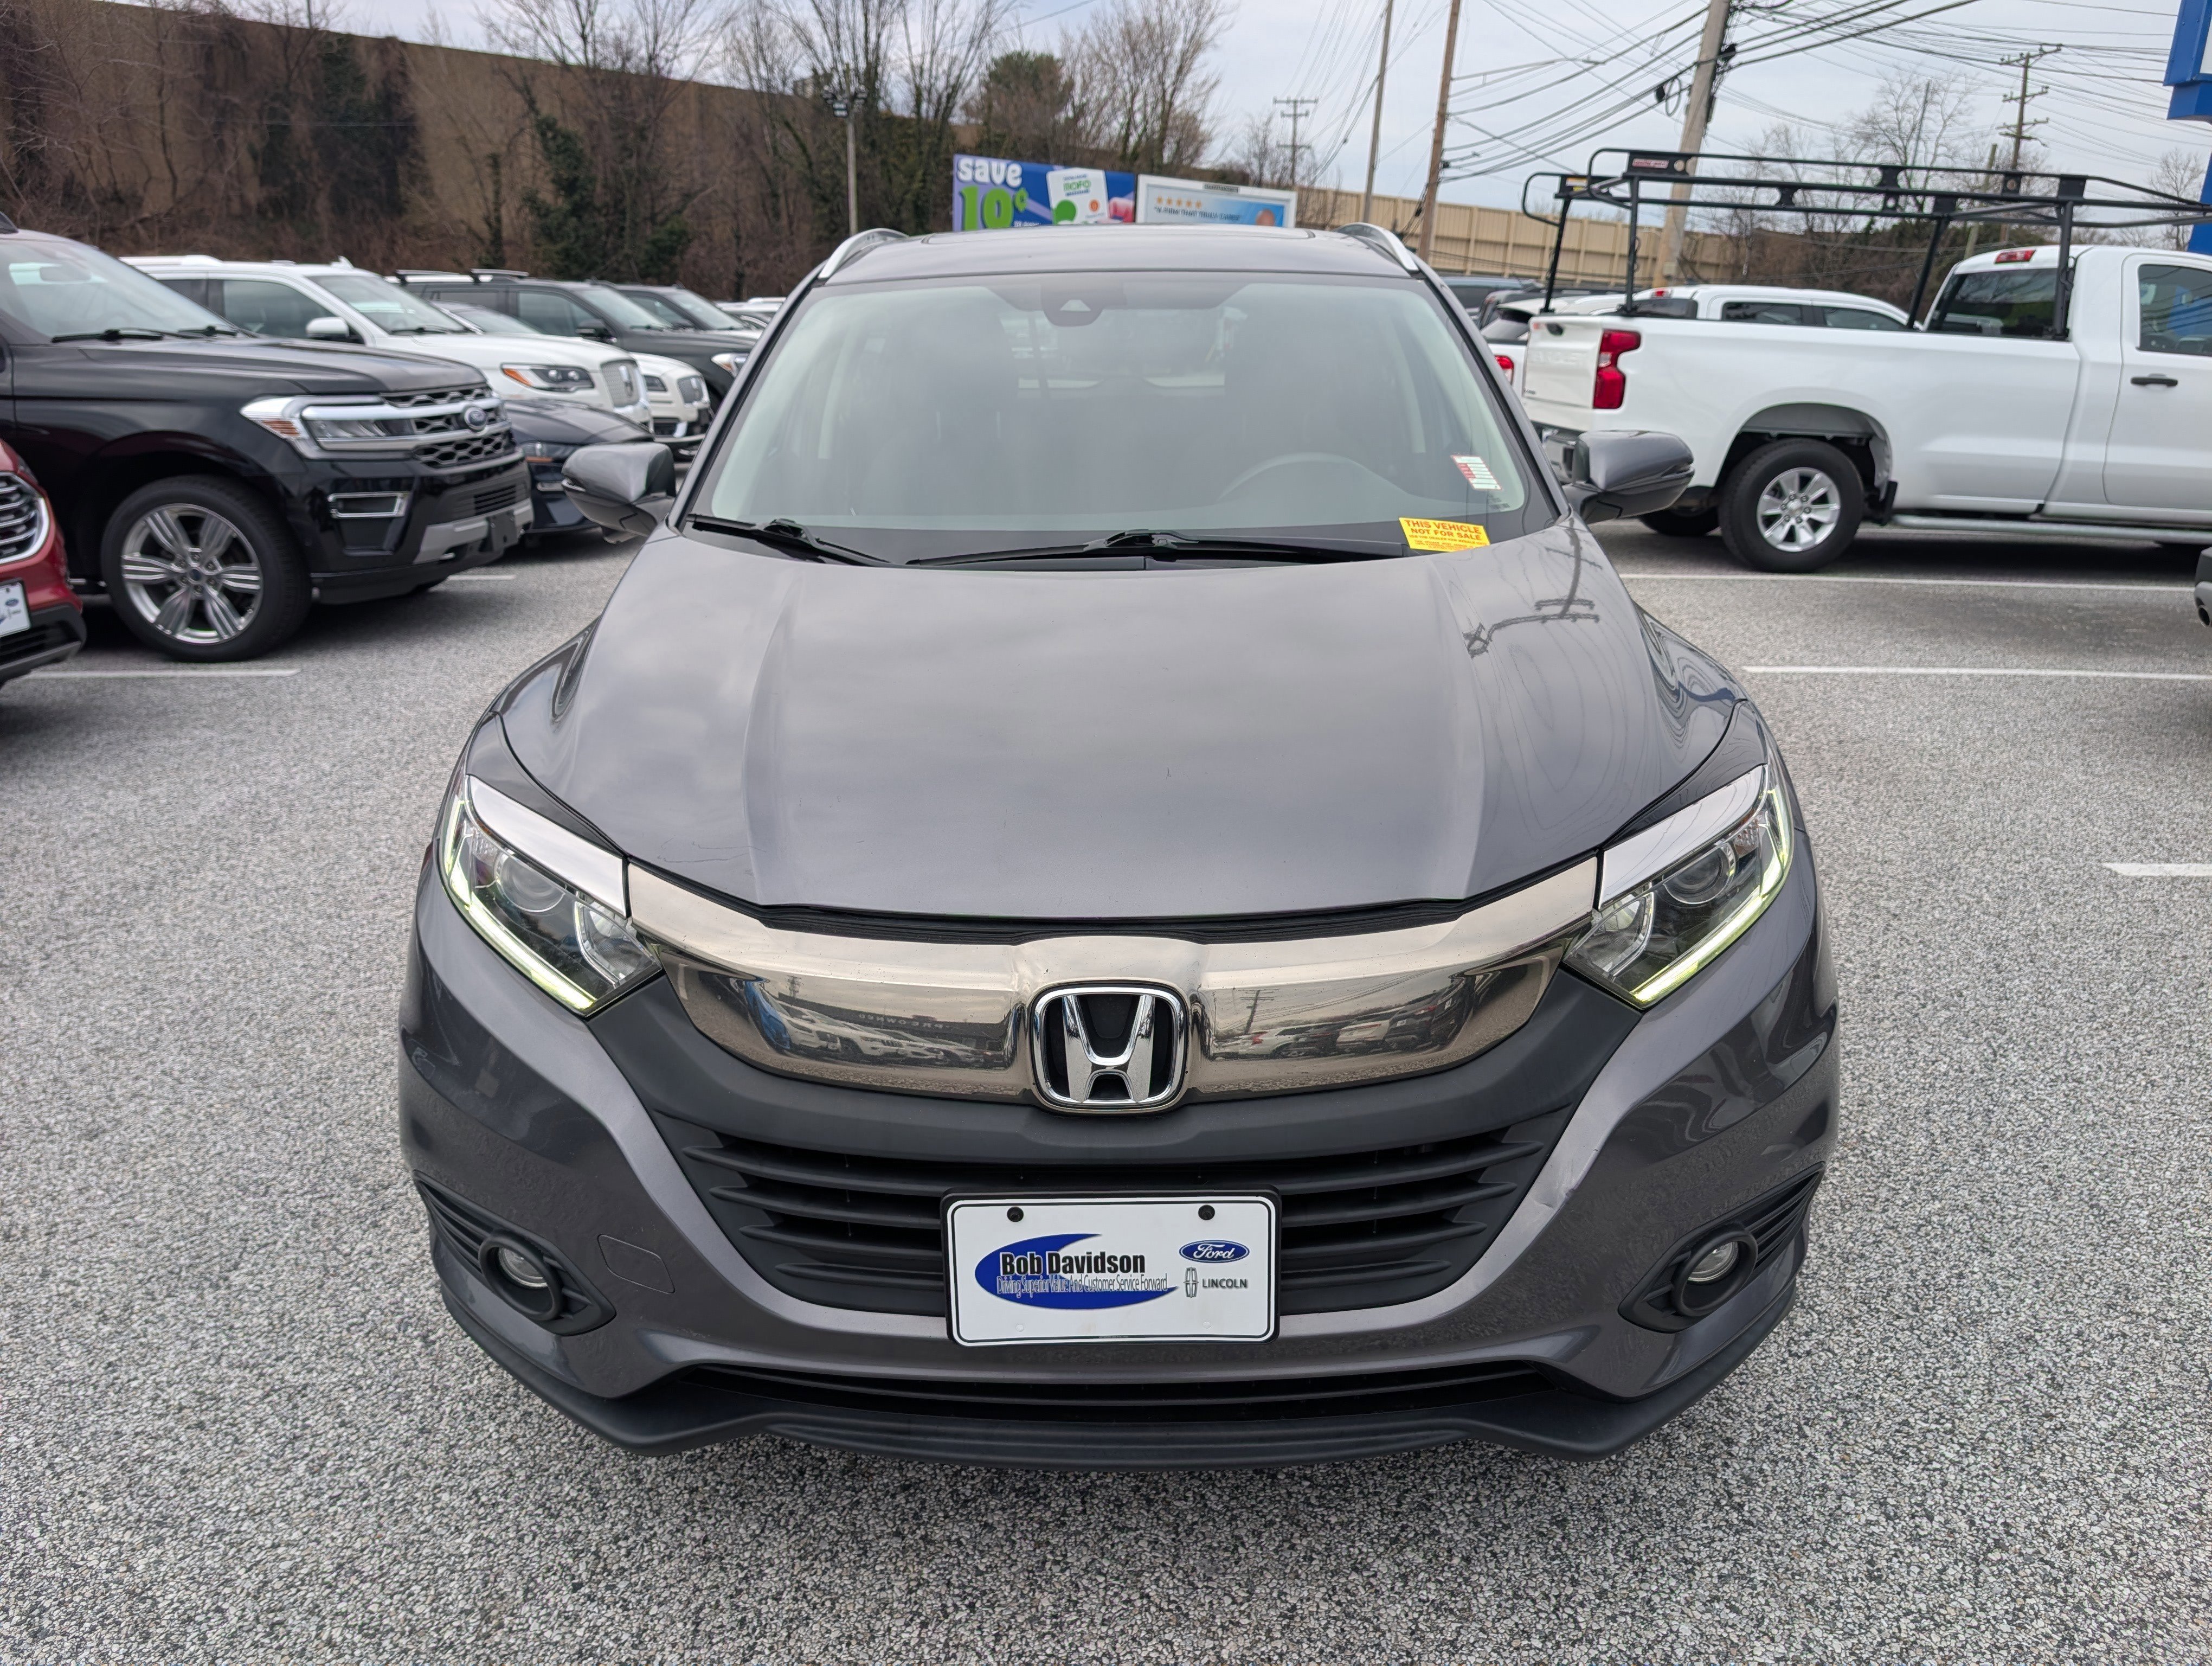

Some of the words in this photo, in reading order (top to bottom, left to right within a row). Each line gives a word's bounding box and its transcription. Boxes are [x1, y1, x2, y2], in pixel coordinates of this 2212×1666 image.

[957, 158, 1023, 188] save
[1404, 520, 1431, 528] THIS
[1433, 522, 1481, 534] VEHICLE
[1457, 532, 1482, 541] SALE
[1193, 1243, 1236, 1259] Ford
[1000, 1252, 1043, 1276] Bob
[1046, 1251, 1145, 1274] Davidson
[997, 1276, 1021, 1298] Driving
[1021, 1274, 1050, 1298] Superior
[1049, 1274, 1069, 1292] Value
[1069, 1274, 1083, 1292] And
[1084, 1274, 1115, 1291] Customer
[1116, 1274, 1140, 1291] Service
[1140, 1273, 1167, 1291] Forward
[1202, 1278, 1248, 1288] LINCOLN
